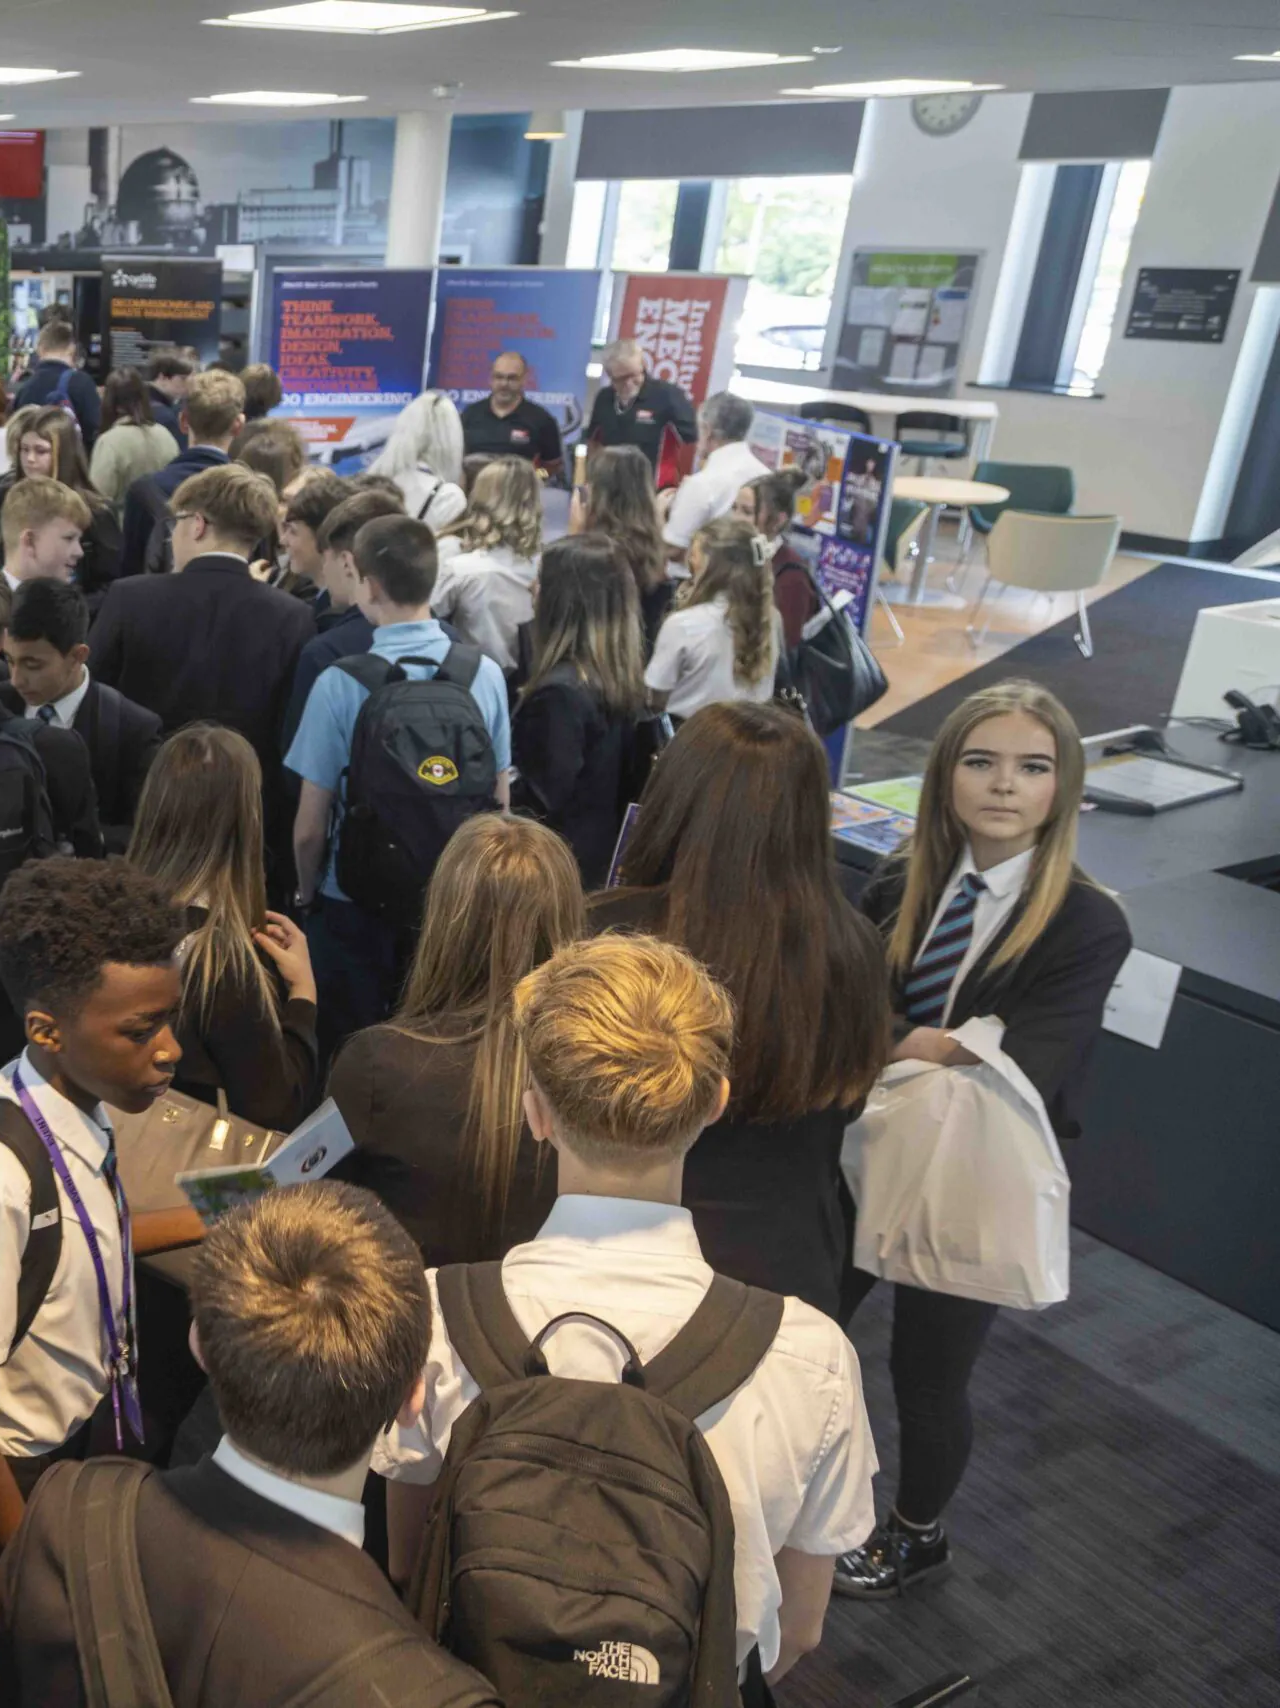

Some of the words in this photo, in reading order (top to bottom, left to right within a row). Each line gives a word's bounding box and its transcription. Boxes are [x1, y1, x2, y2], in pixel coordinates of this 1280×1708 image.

[600, 1640, 631, 1655] THE
[573, 1649, 630, 1668] NORTH
[588, 1663, 630, 1680] FACE
